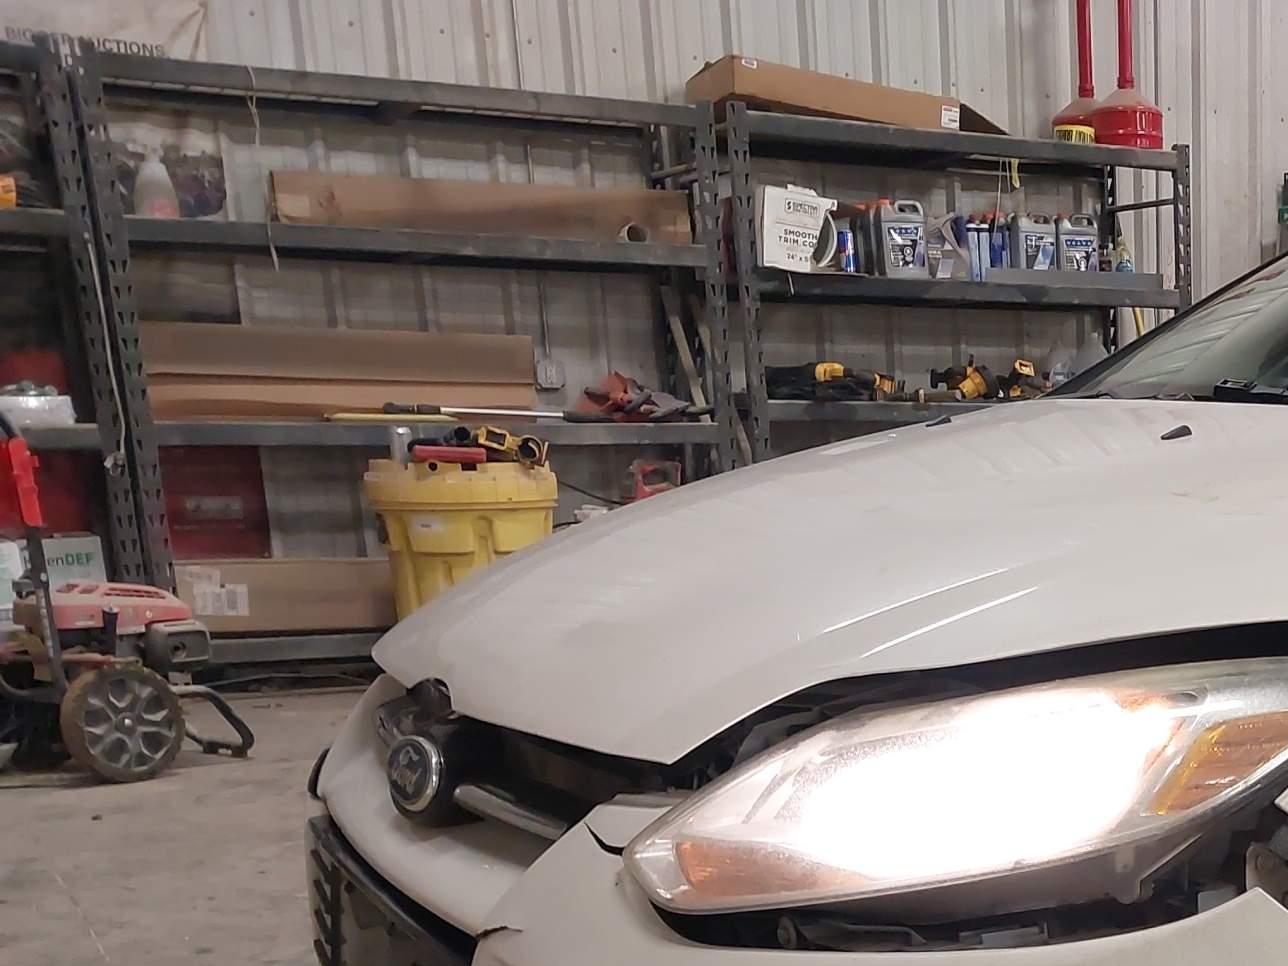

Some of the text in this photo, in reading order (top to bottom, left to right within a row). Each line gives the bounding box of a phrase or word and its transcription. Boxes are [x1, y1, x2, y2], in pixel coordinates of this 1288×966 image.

[5, 26, 33, 41] BIG
[783, 228, 818, 241] SMOOTH
[778, 235, 818, 248] TRIM CO
